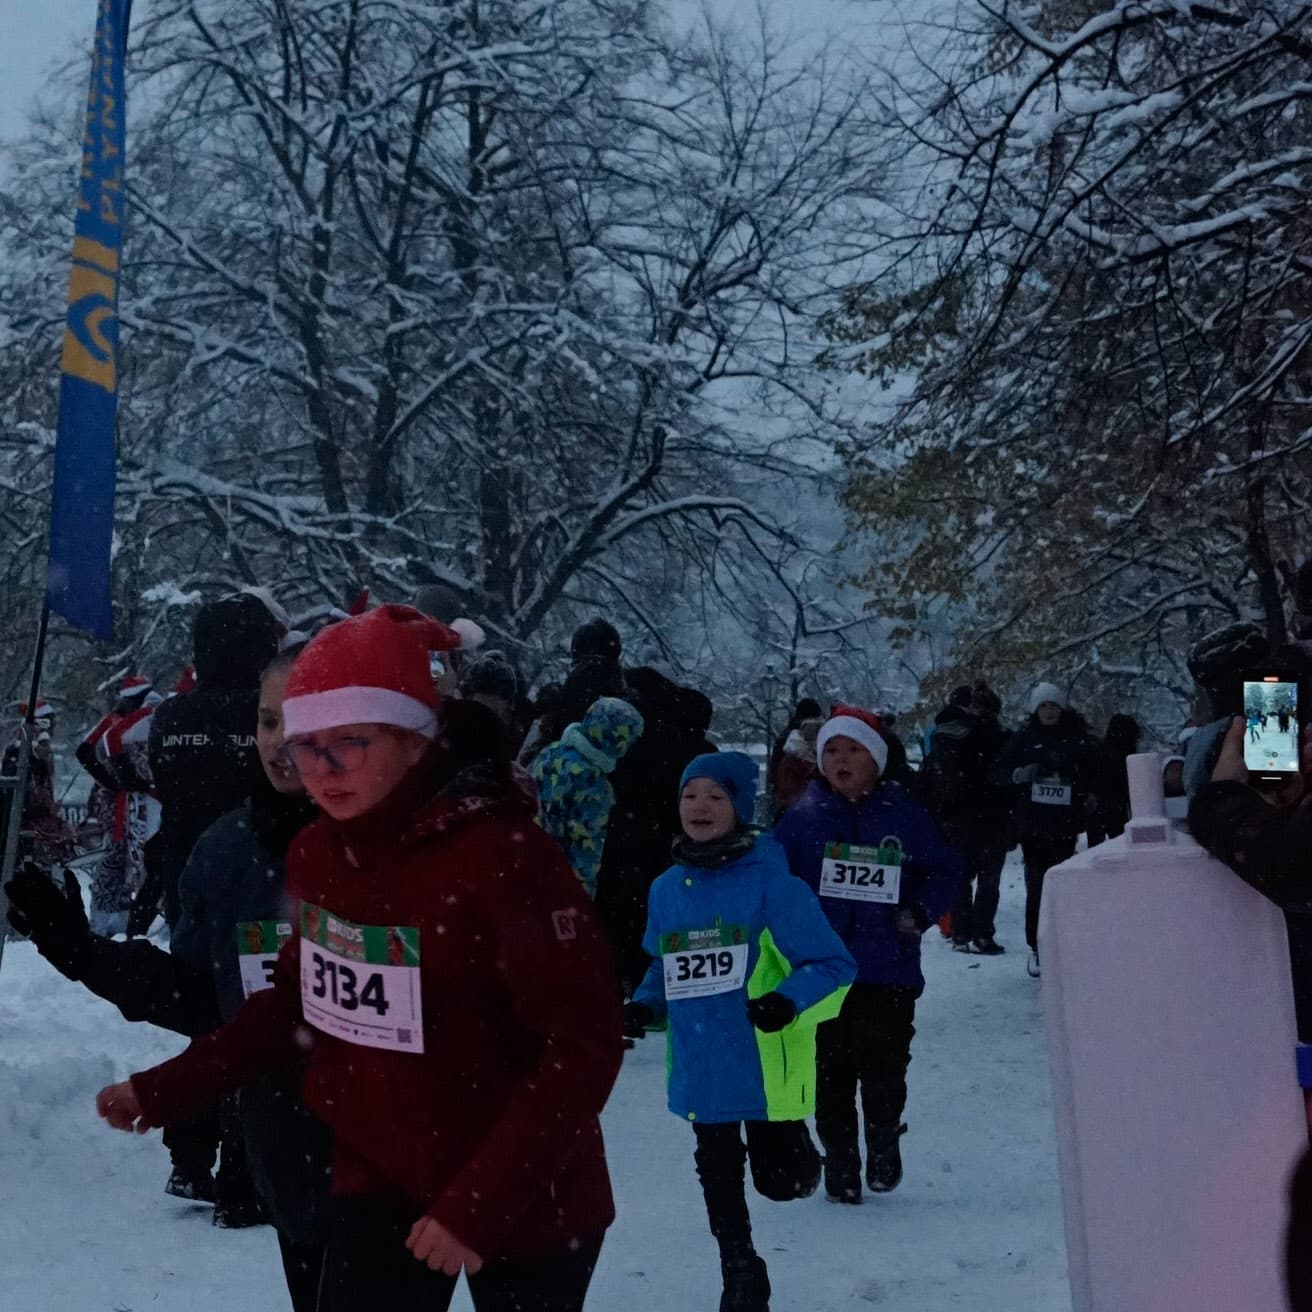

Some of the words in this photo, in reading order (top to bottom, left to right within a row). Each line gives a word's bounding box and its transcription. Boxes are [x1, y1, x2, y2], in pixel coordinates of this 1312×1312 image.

[833, 863, 884, 887] 3124
[676, 951, 733, 981] 3219
[313, 952, 390, 1016] 3134
